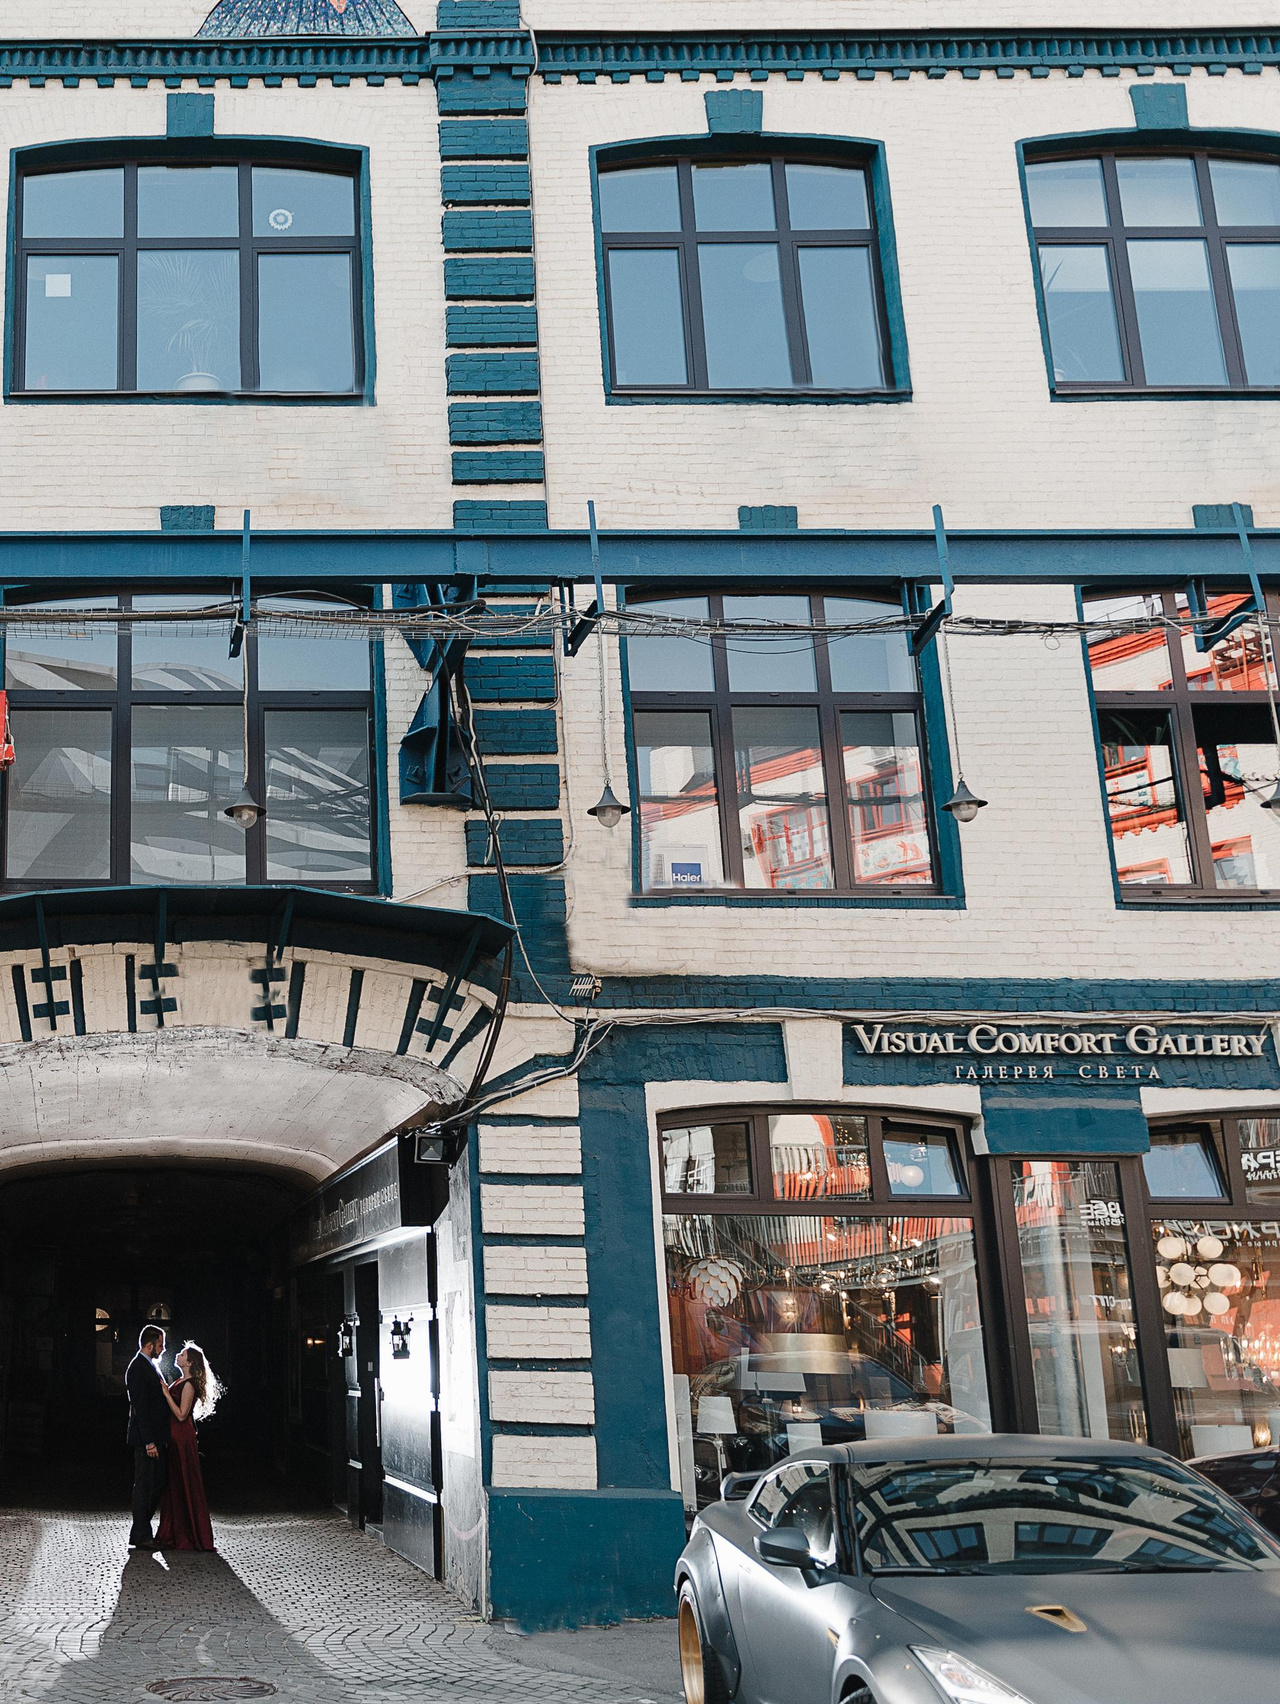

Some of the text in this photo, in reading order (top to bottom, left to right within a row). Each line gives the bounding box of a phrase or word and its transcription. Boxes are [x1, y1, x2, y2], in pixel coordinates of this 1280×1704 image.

[672, 872, 701, 882] Haier
[851, 1024, 1268, 1056] VISUAL COMFORT GALLERY
[955, 1065, 1160, 1079] ГАЛЕРЕЯ СВЕТА
